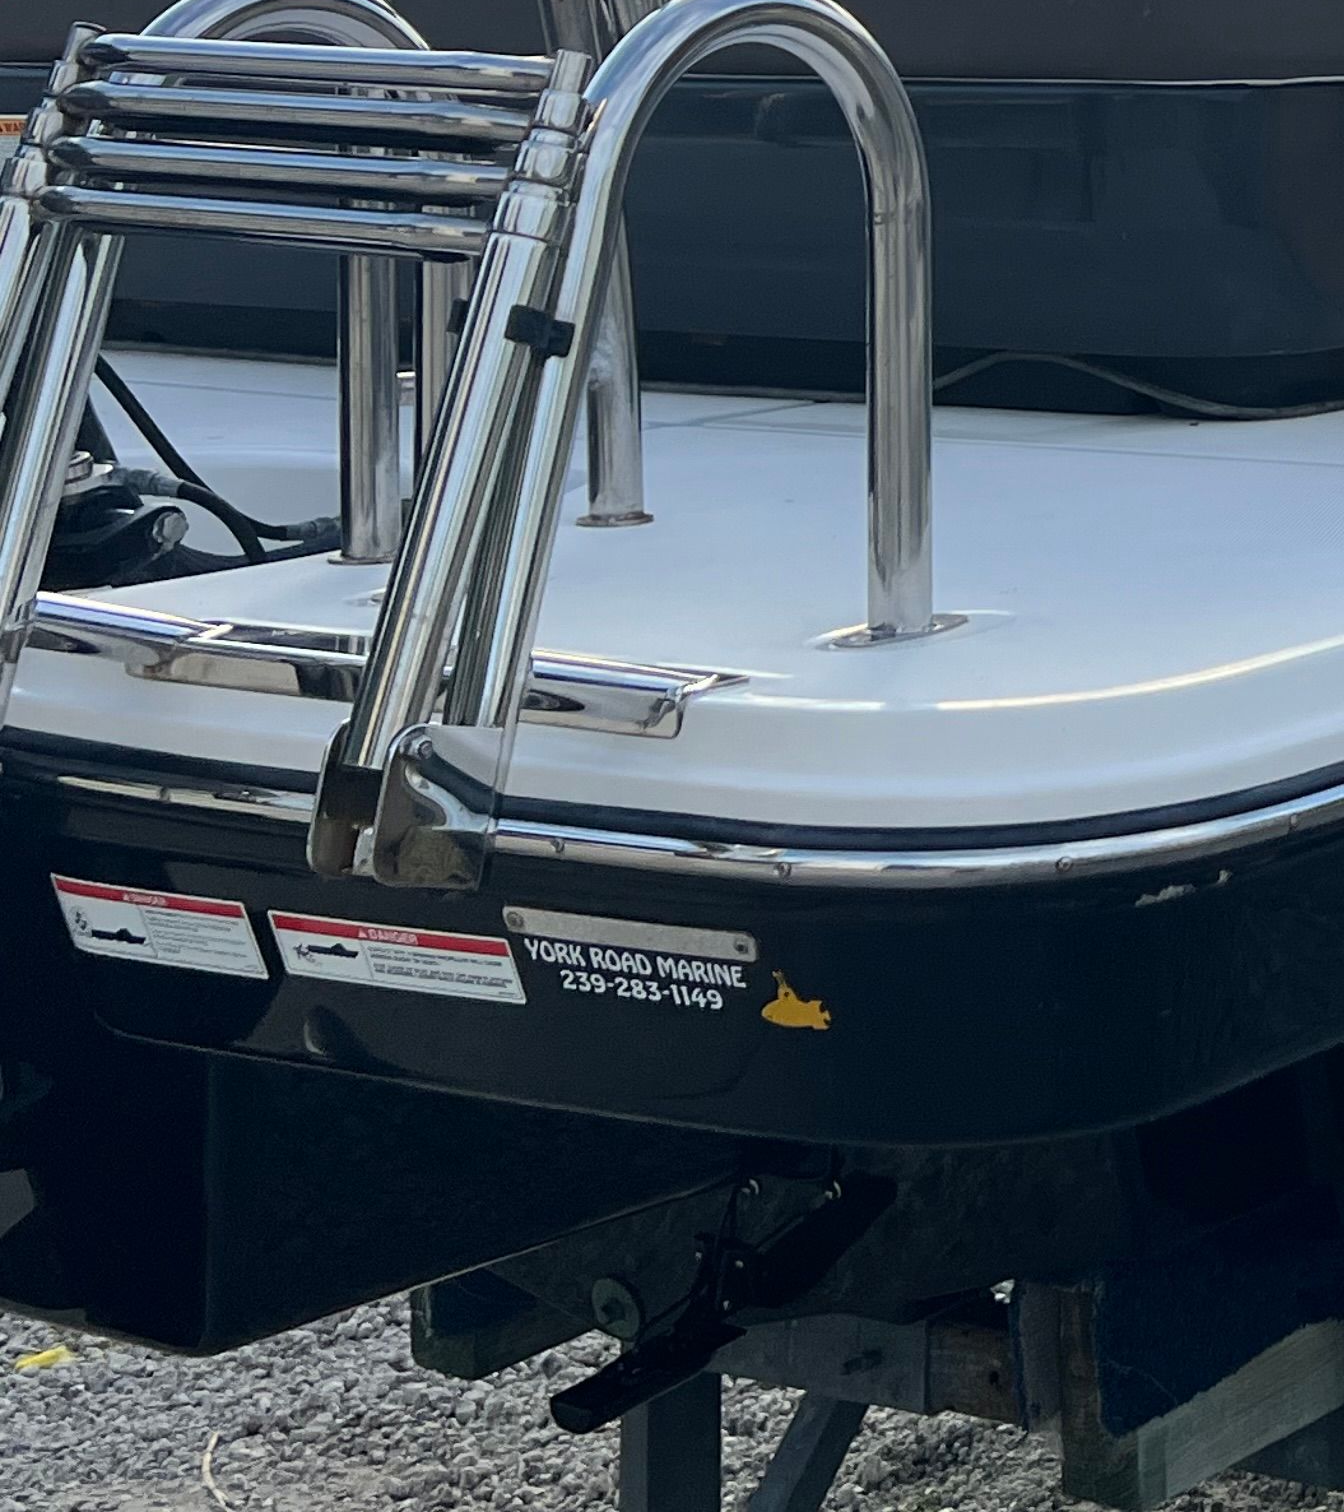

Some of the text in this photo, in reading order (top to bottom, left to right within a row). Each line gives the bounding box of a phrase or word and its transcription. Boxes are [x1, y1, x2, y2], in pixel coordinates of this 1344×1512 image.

[367, 928, 419, 946] DANGER
[524, 937, 586, 967] YORK
[589, 947, 652, 975] ROAD
[656, 955, 747, 989] MARINE
[559, 970, 724, 1010] 239-283-1149
